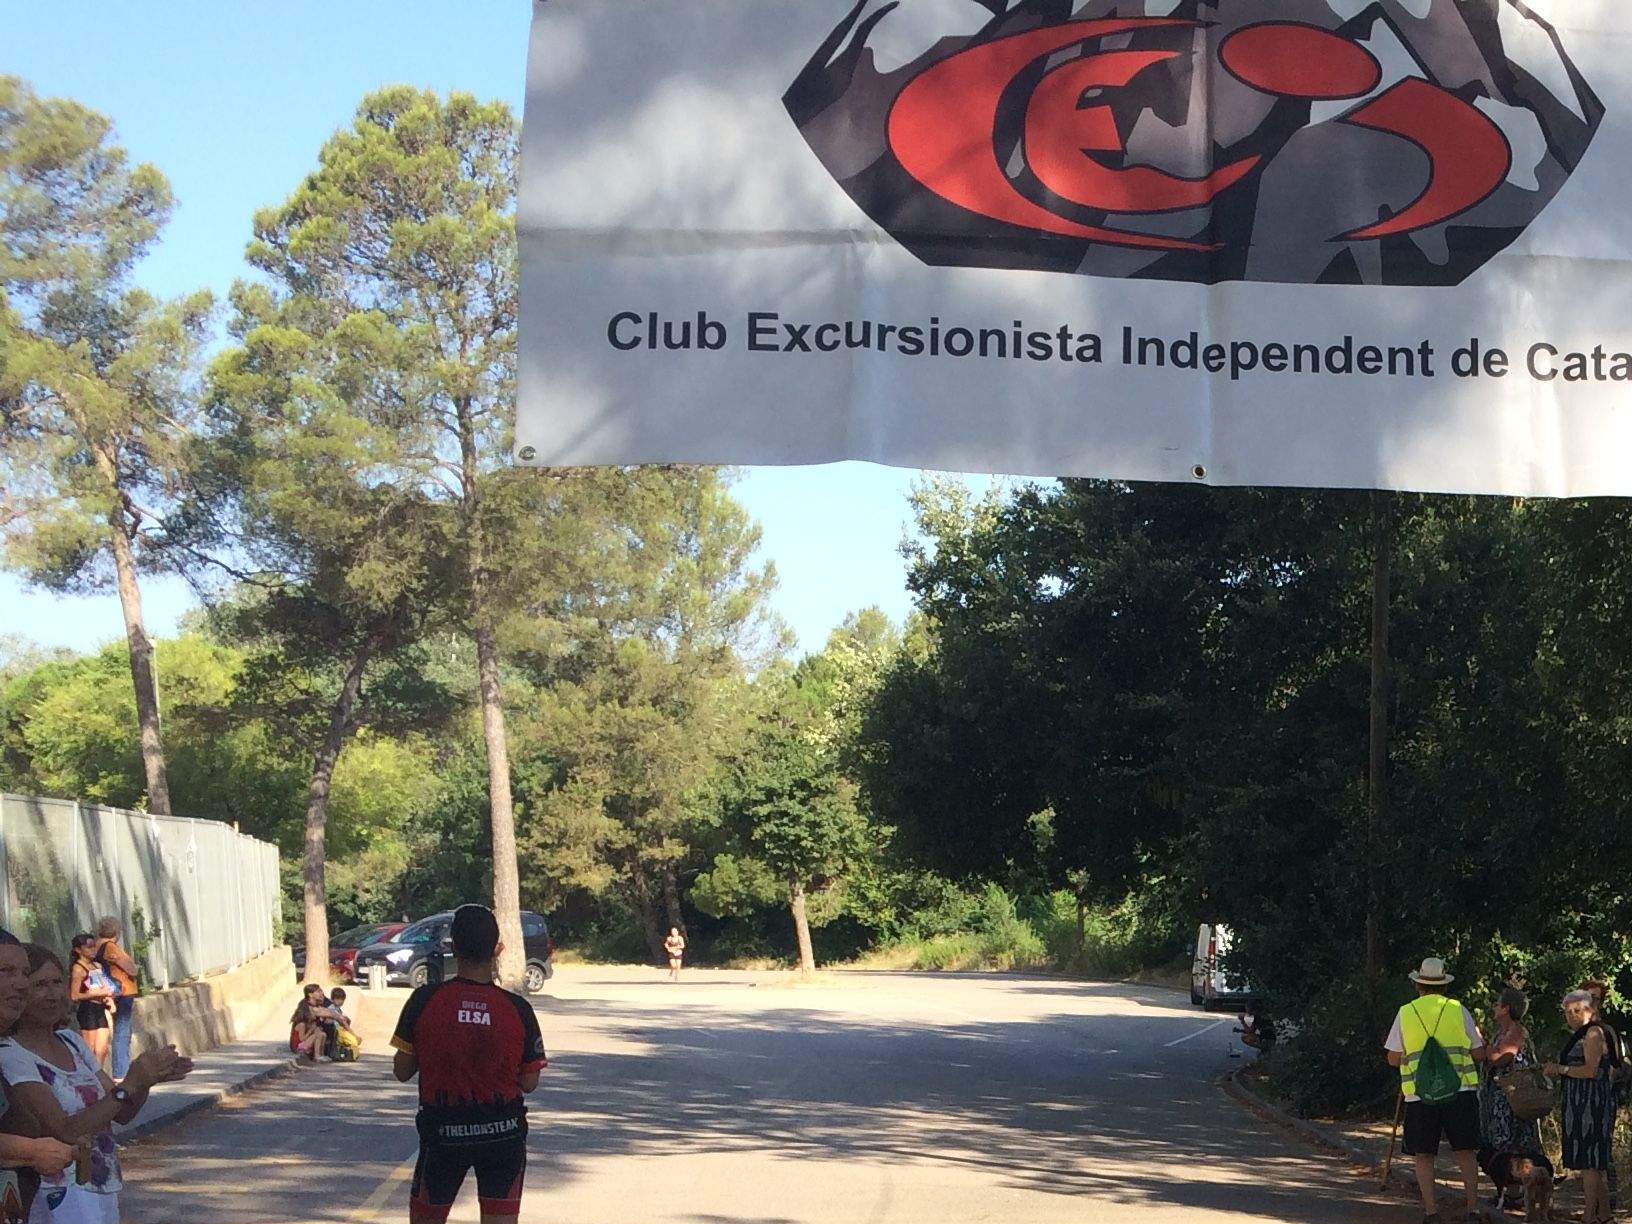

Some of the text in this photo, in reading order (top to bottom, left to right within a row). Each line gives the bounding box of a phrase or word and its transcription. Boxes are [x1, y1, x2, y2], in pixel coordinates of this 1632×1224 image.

[606, 311, 728, 351] Club
[746, 312, 1103, 364] Excursionista
[1121, 326, 1434, 380] Independent
[1450, 338, 1510, 378] de
[458, 1010, 491, 1025] ELSA
